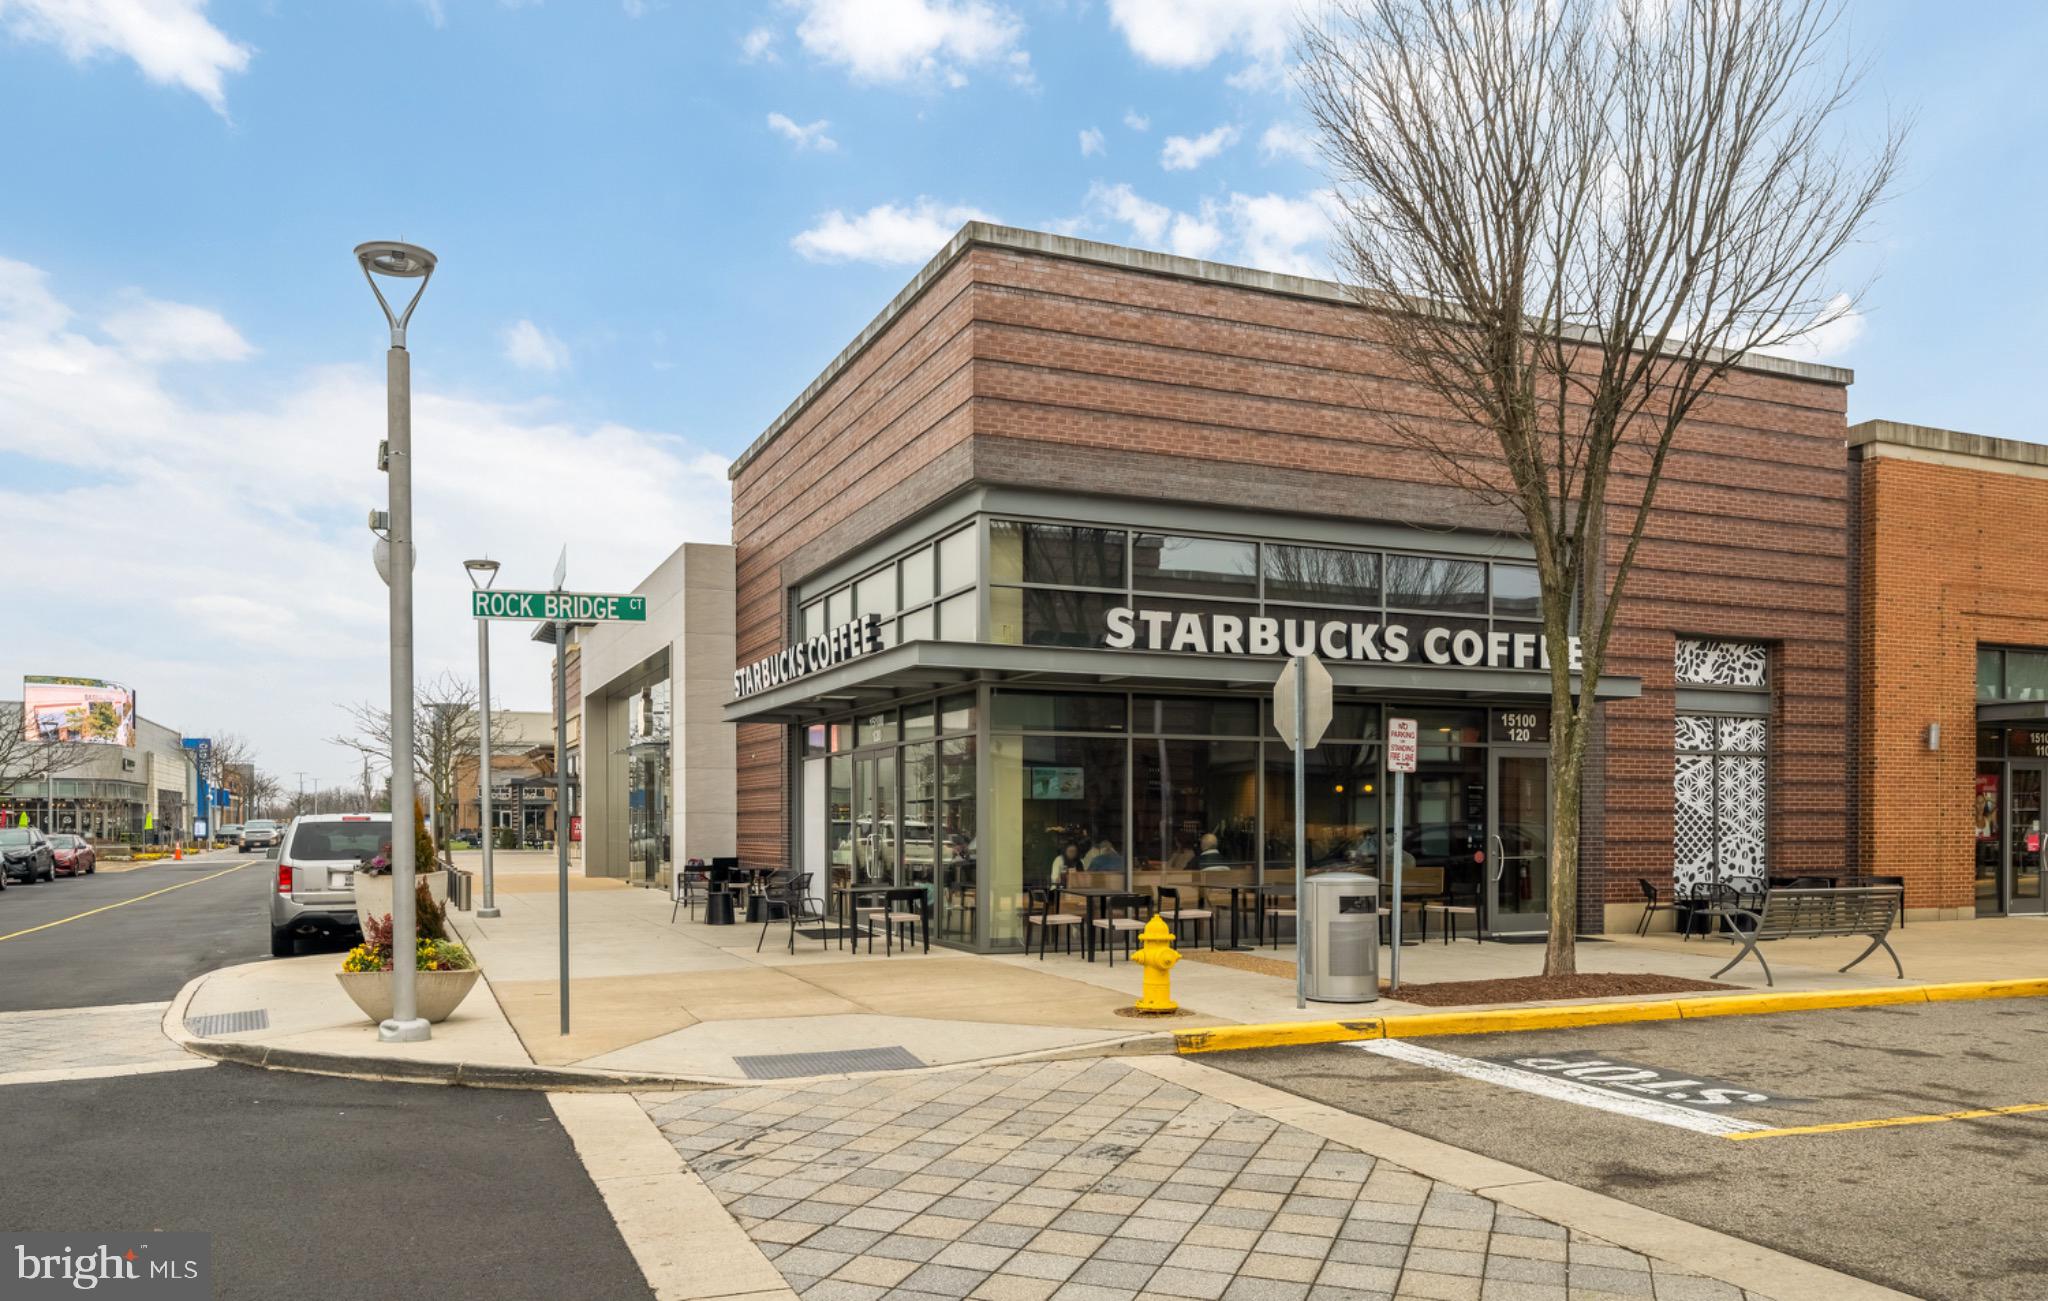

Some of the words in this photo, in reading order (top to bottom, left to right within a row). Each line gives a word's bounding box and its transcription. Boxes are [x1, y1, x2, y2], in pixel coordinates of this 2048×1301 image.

[475, 593, 533, 617] ROCK
[544, 595, 620, 619] BRIDGE
[629, 598, 643, 610] CT
[1104, 607, 1409, 663] STARBUCKS
[733, 642, 806, 698] STARBUCKS
[807, 614, 876, 673] COFFEE
[1398, 722, 1408, 730] NO
[1501, 713, 1537, 728] 15100
[1391, 730, 1415, 739] PARKING
[1508, 728, 1530, 742] 120
[1390, 751, 1400, 761] FIRE
[1402, 753, 1414, 762] LANE
[1513, 1057, 1769, 1105] STOP
